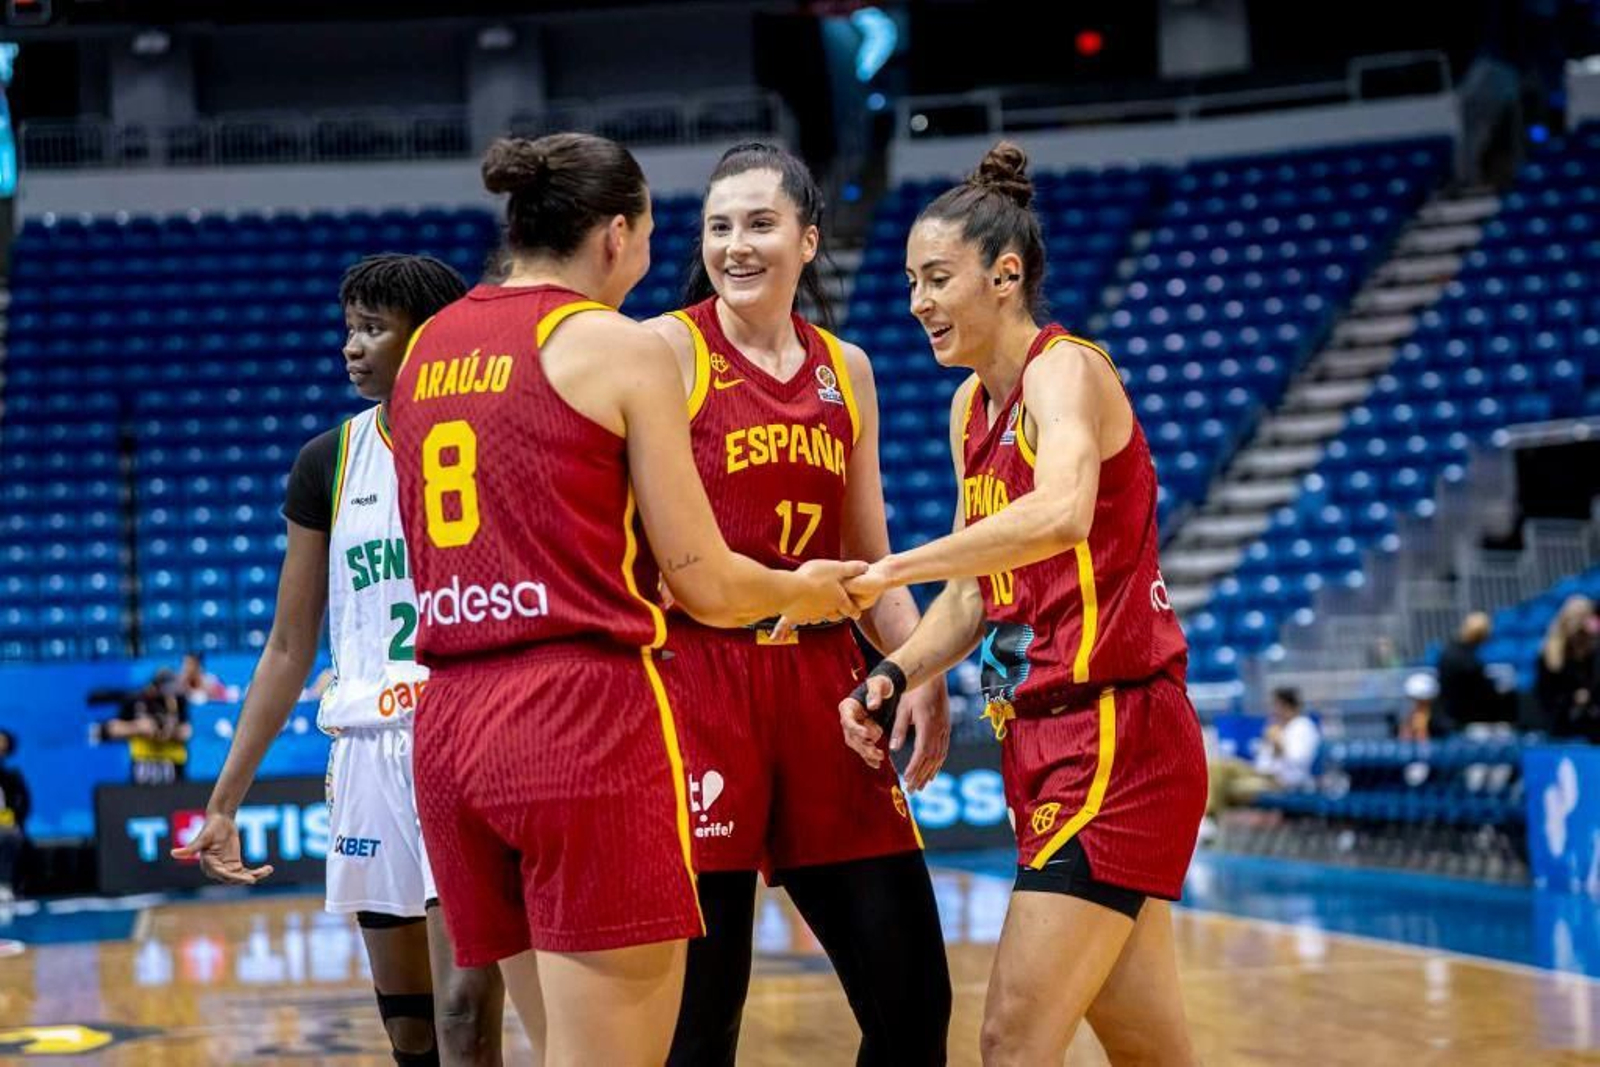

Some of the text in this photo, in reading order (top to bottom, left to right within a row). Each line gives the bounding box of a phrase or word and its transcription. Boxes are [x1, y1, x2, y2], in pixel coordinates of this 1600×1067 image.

[413, 349, 513, 402] ARAÚJO
[725, 422, 846, 486] ESPAÑA
[422, 419, 480, 548] 8
[775, 500, 822, 556] 17
[346, 538, 413, 592] SEN
[419, 575, 549, 626] ndesa
[388, 601, 417, 661] 2
